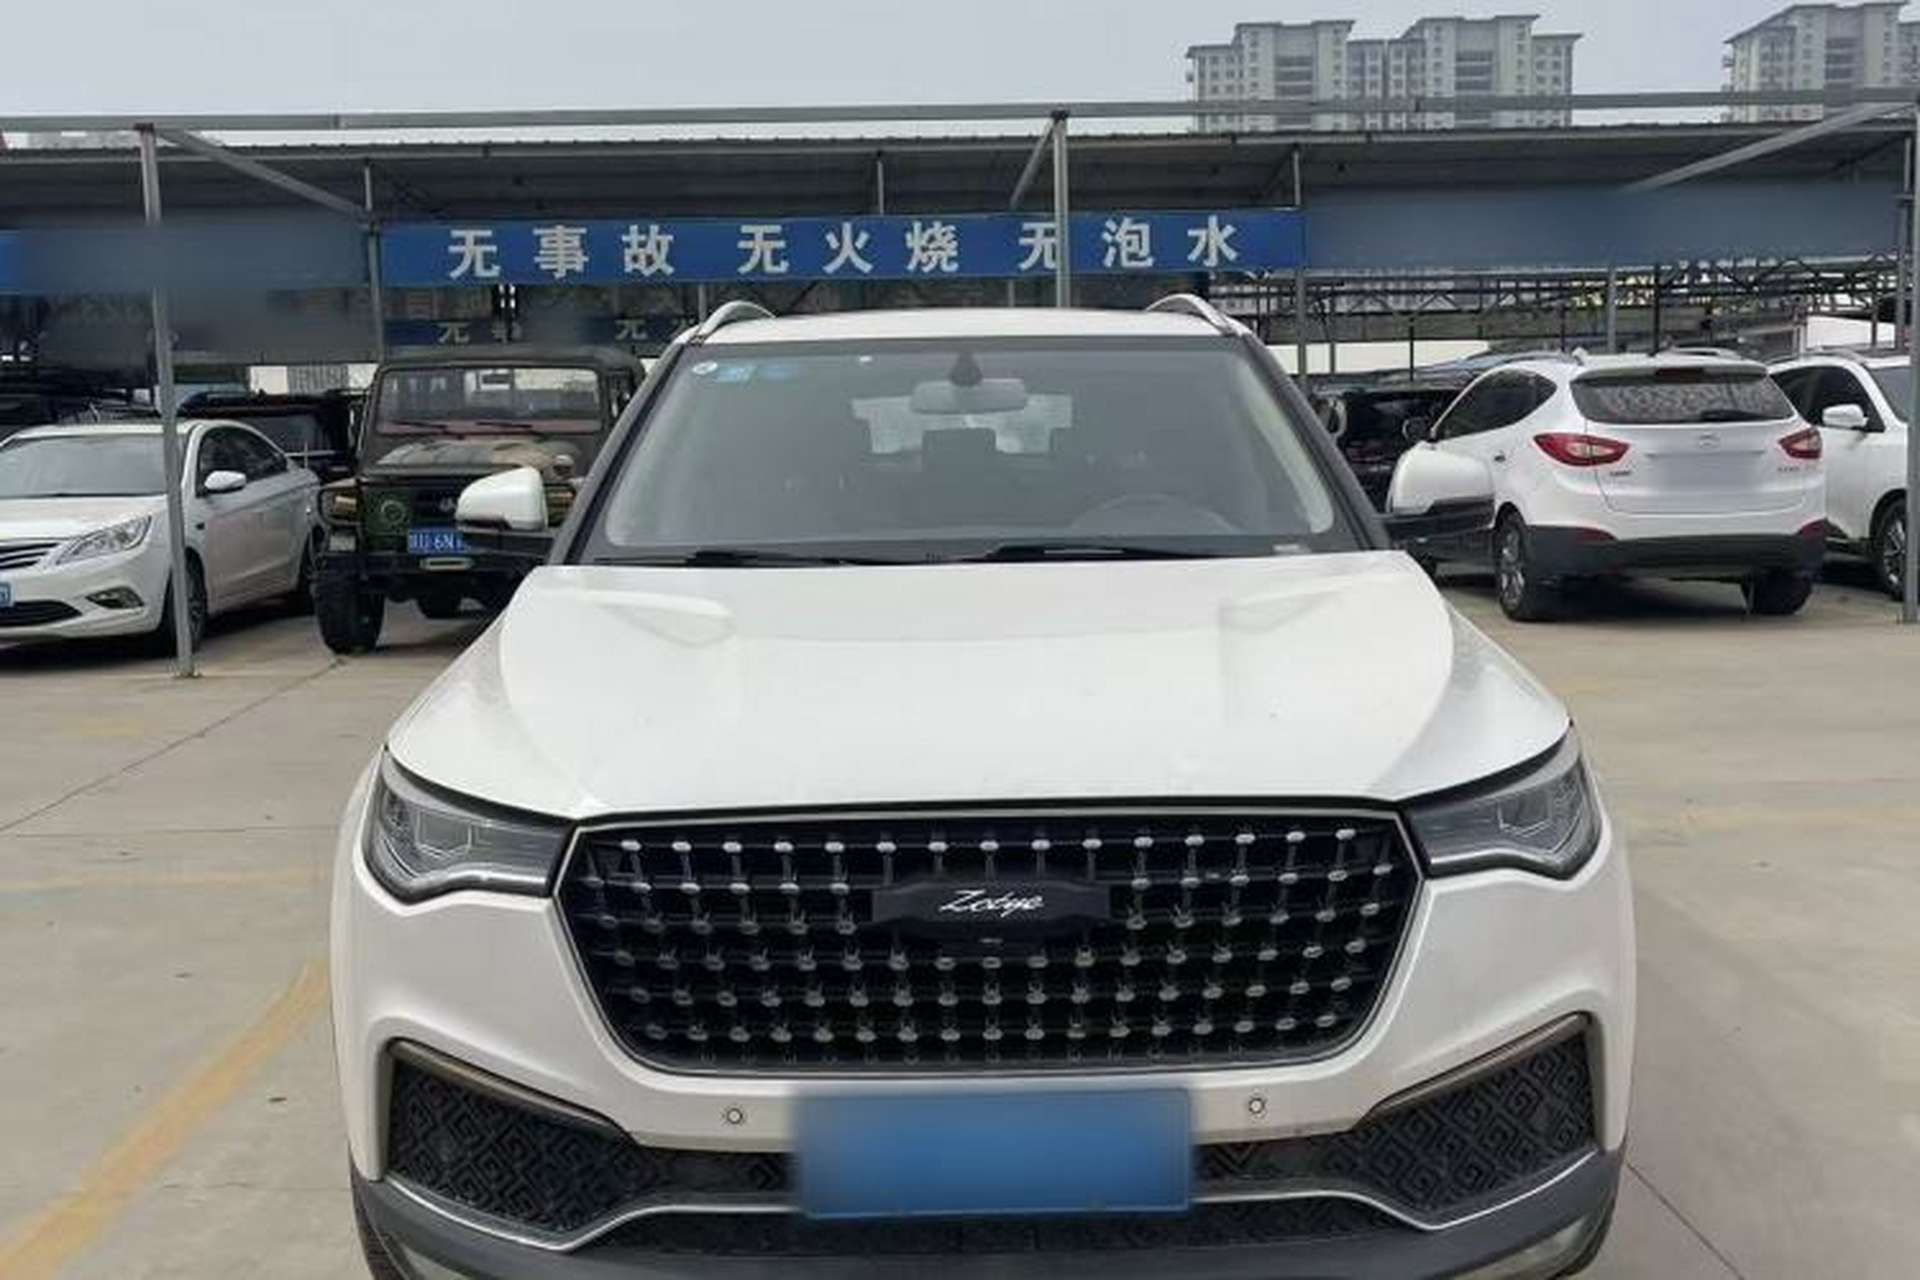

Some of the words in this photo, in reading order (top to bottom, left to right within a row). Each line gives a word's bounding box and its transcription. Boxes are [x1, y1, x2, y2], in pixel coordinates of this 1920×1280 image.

[449, 224, 674, 279] 无事故
[737, 221, 960, 276] 无火烧
[1018, 214, 1240, 272] 无泡水
[938, 889, 1045, 918] Zotye
